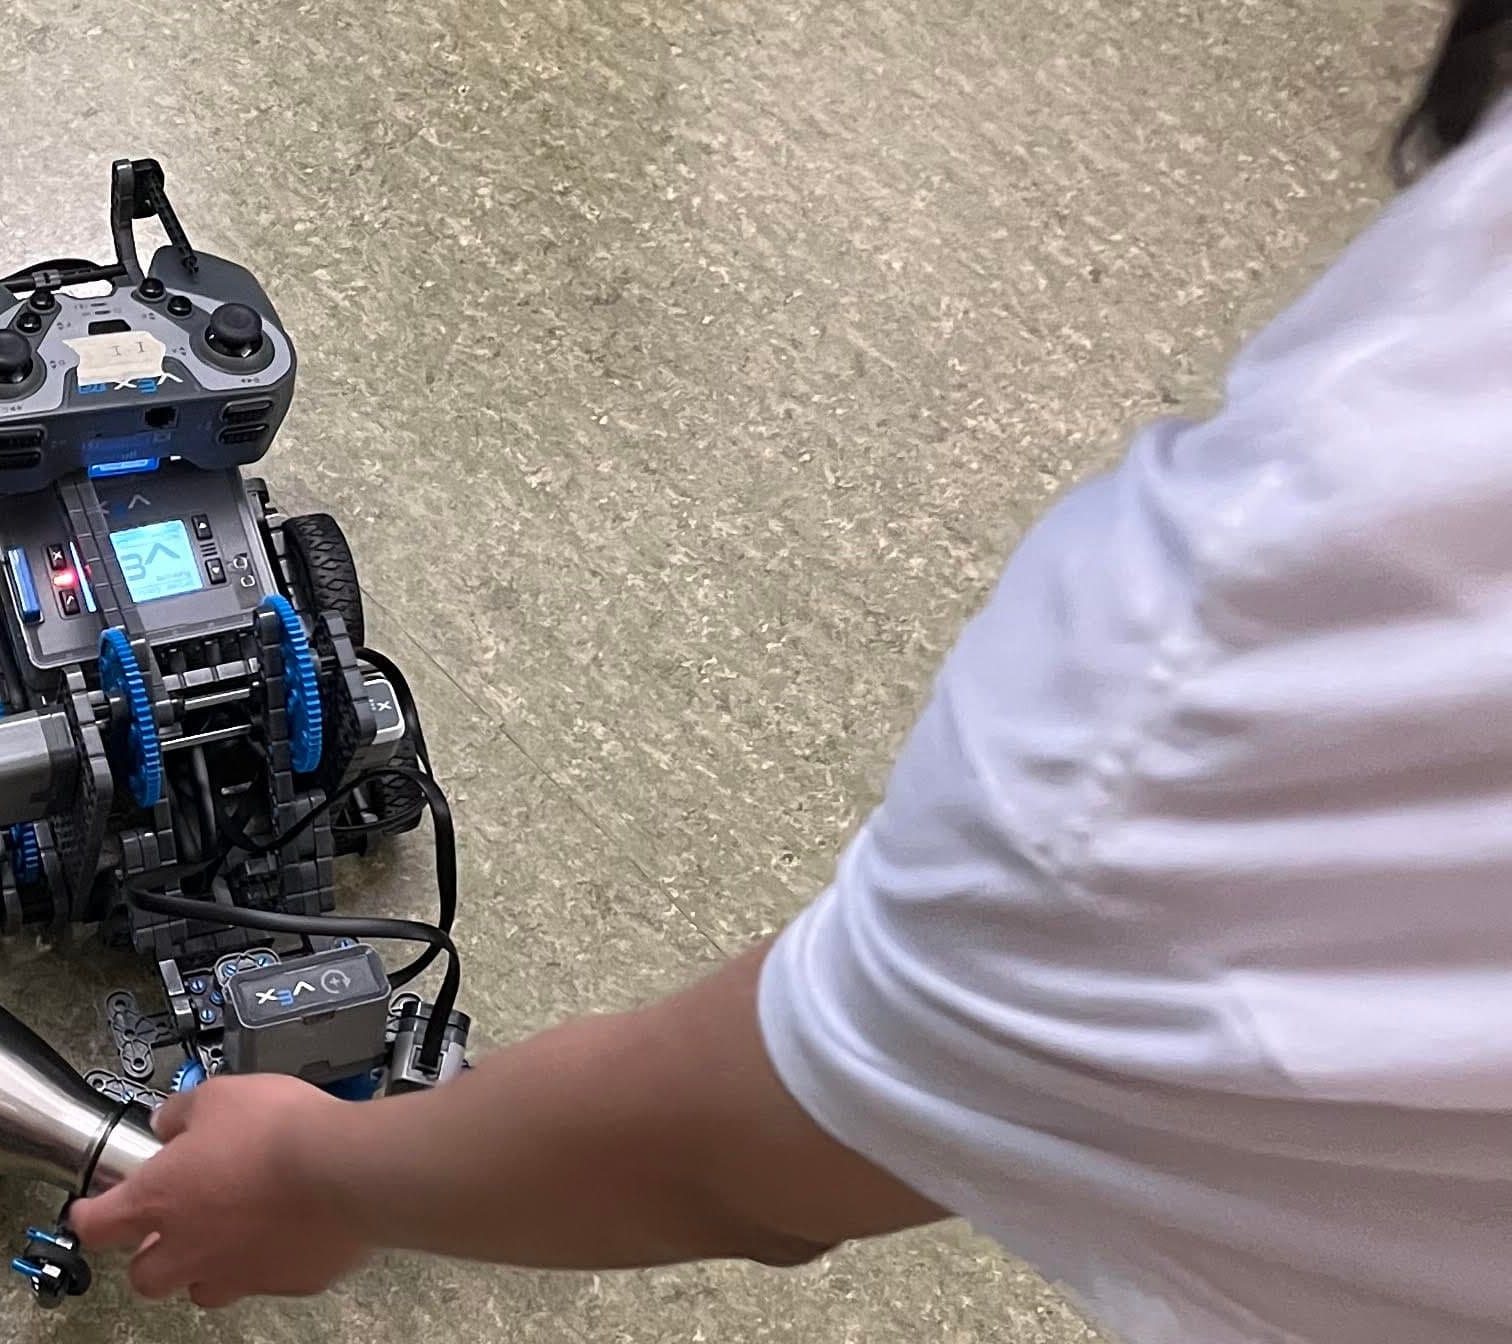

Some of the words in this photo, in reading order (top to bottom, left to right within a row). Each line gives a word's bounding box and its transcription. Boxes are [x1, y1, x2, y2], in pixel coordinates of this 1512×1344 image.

[96, 494, 152, 520] VX
[121, 542, 181, 582] VE
[255, 980, 316, 1006] VEX
